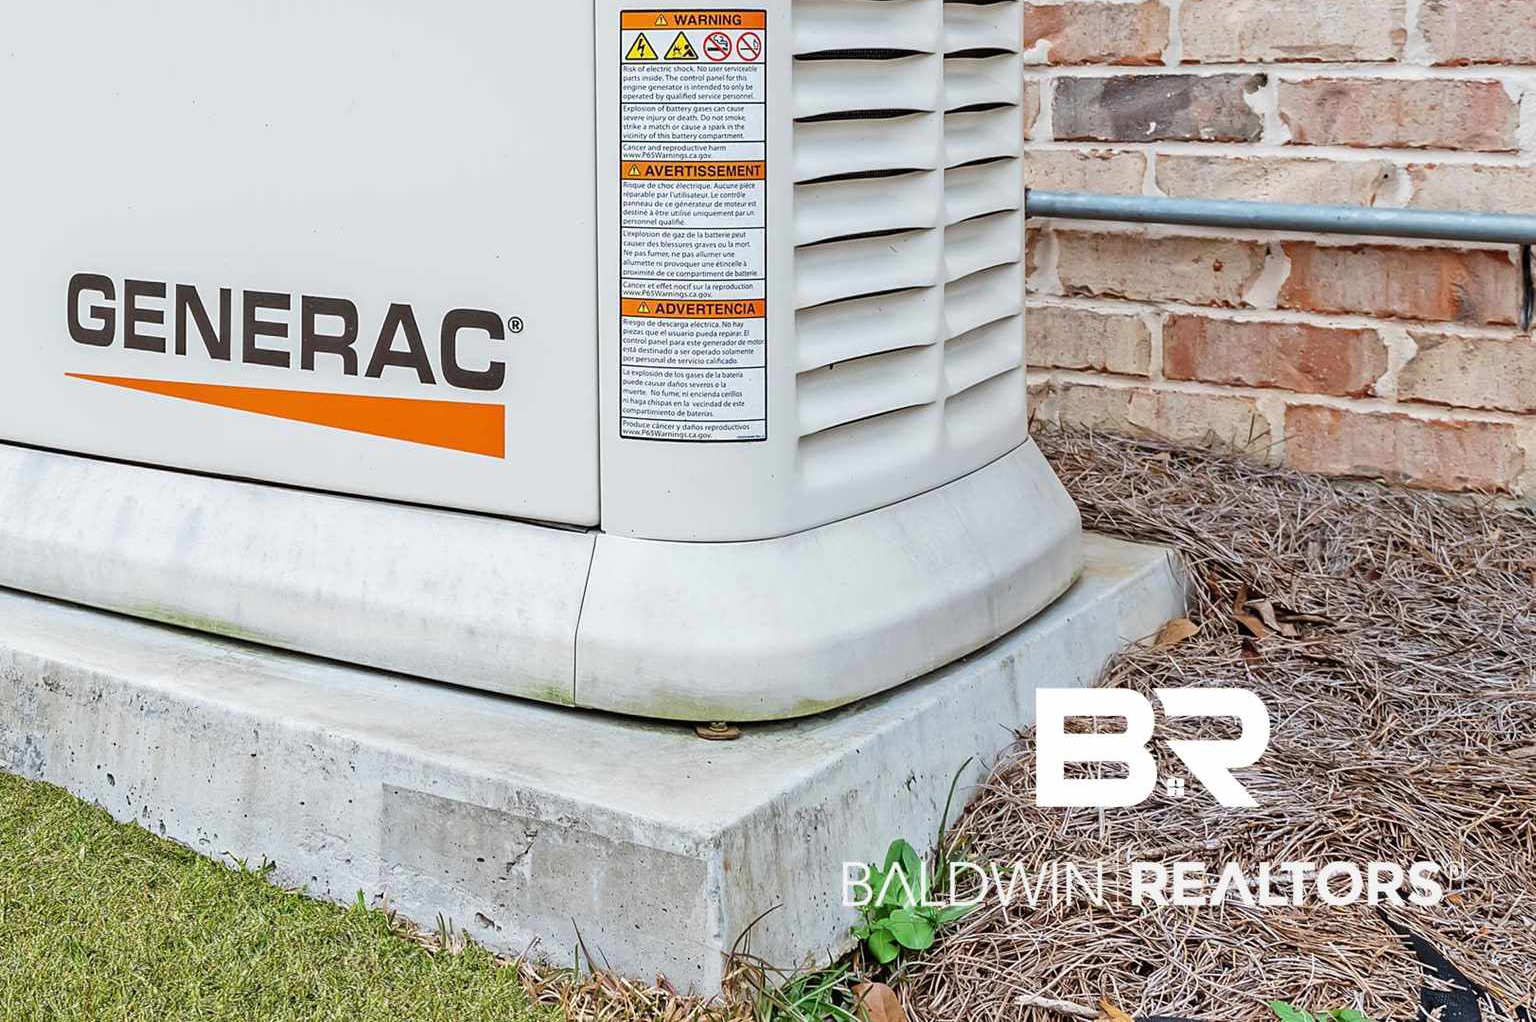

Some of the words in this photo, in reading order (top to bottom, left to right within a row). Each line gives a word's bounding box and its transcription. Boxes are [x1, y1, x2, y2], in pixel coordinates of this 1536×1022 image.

[674, 14, 742, 25] WARNING
[645, 165, 761, 176] AVERTISSEMENT
[655, 303, 756, 315] ADVERTENCIA
